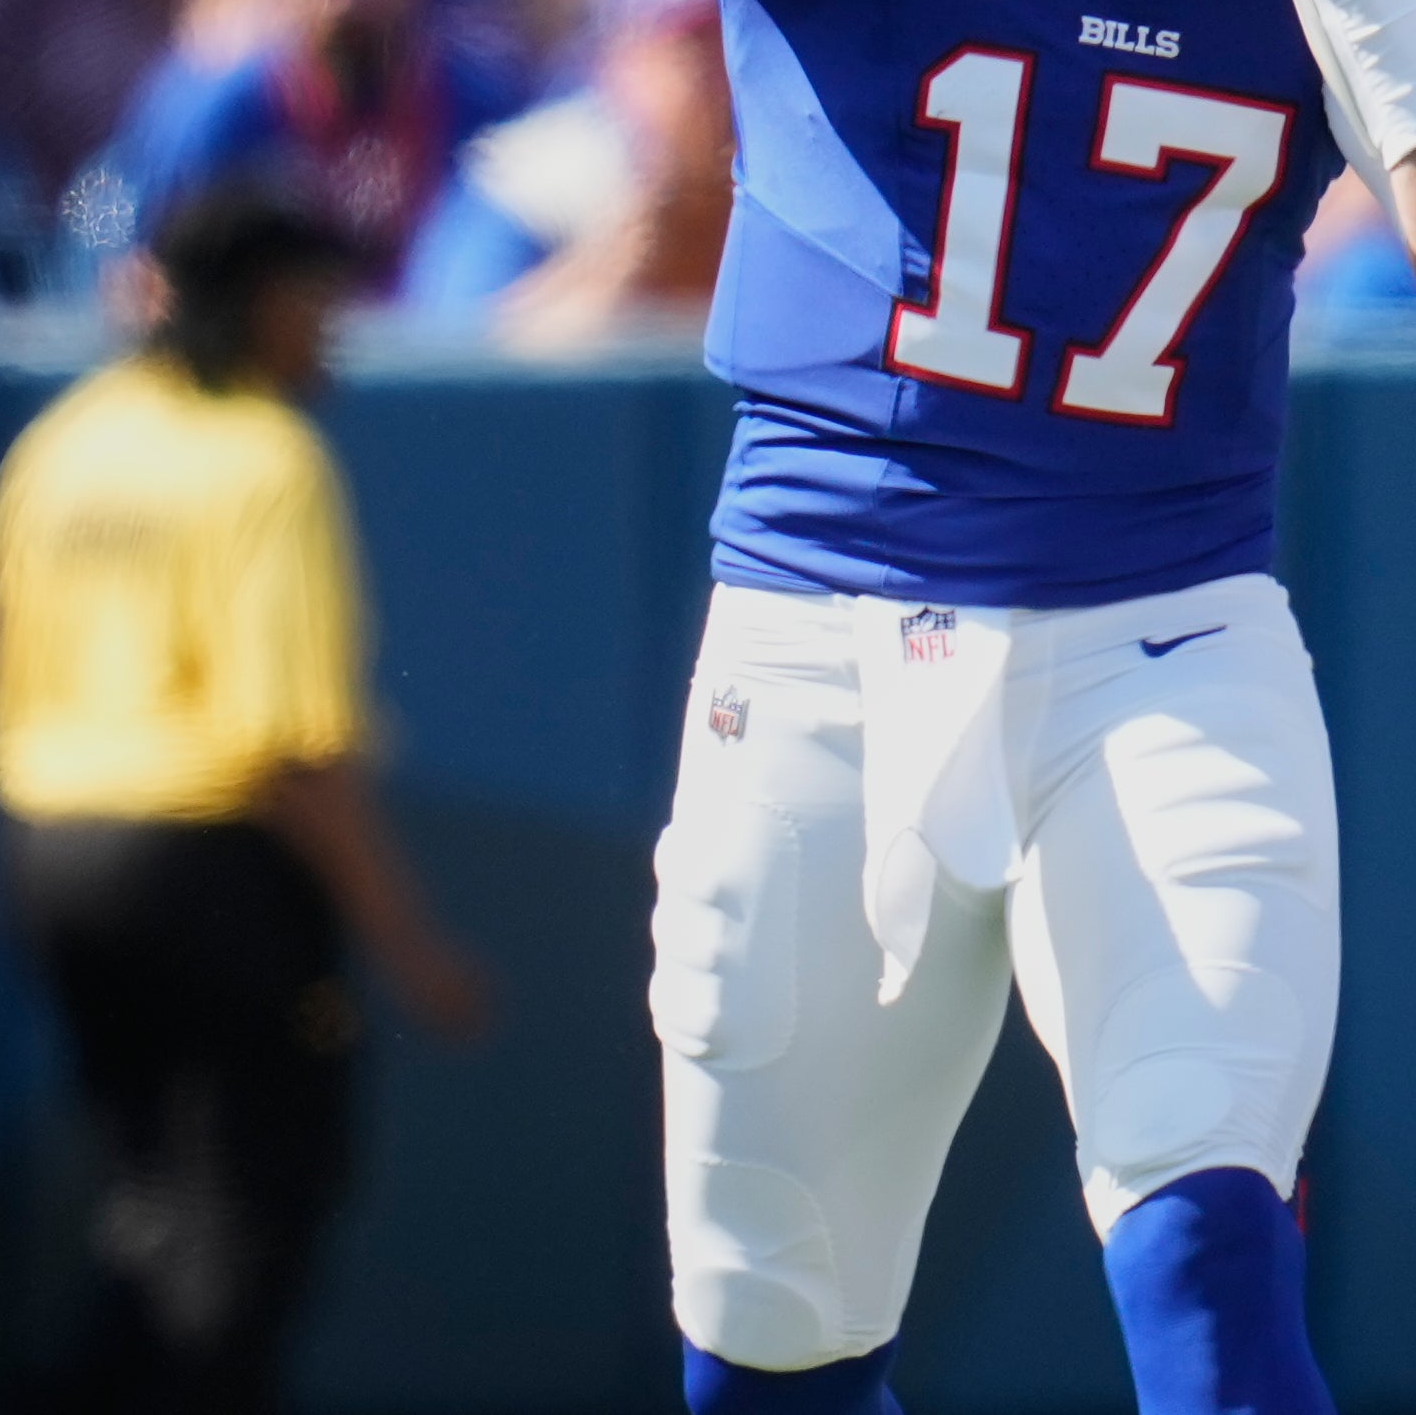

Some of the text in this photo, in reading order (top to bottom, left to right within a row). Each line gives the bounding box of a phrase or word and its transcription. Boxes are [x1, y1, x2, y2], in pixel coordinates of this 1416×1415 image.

[1078, 15, 1181, 59] BILLS
[882, 37, 1299, 429] 17
[906, 632, 956, 664] NFL
